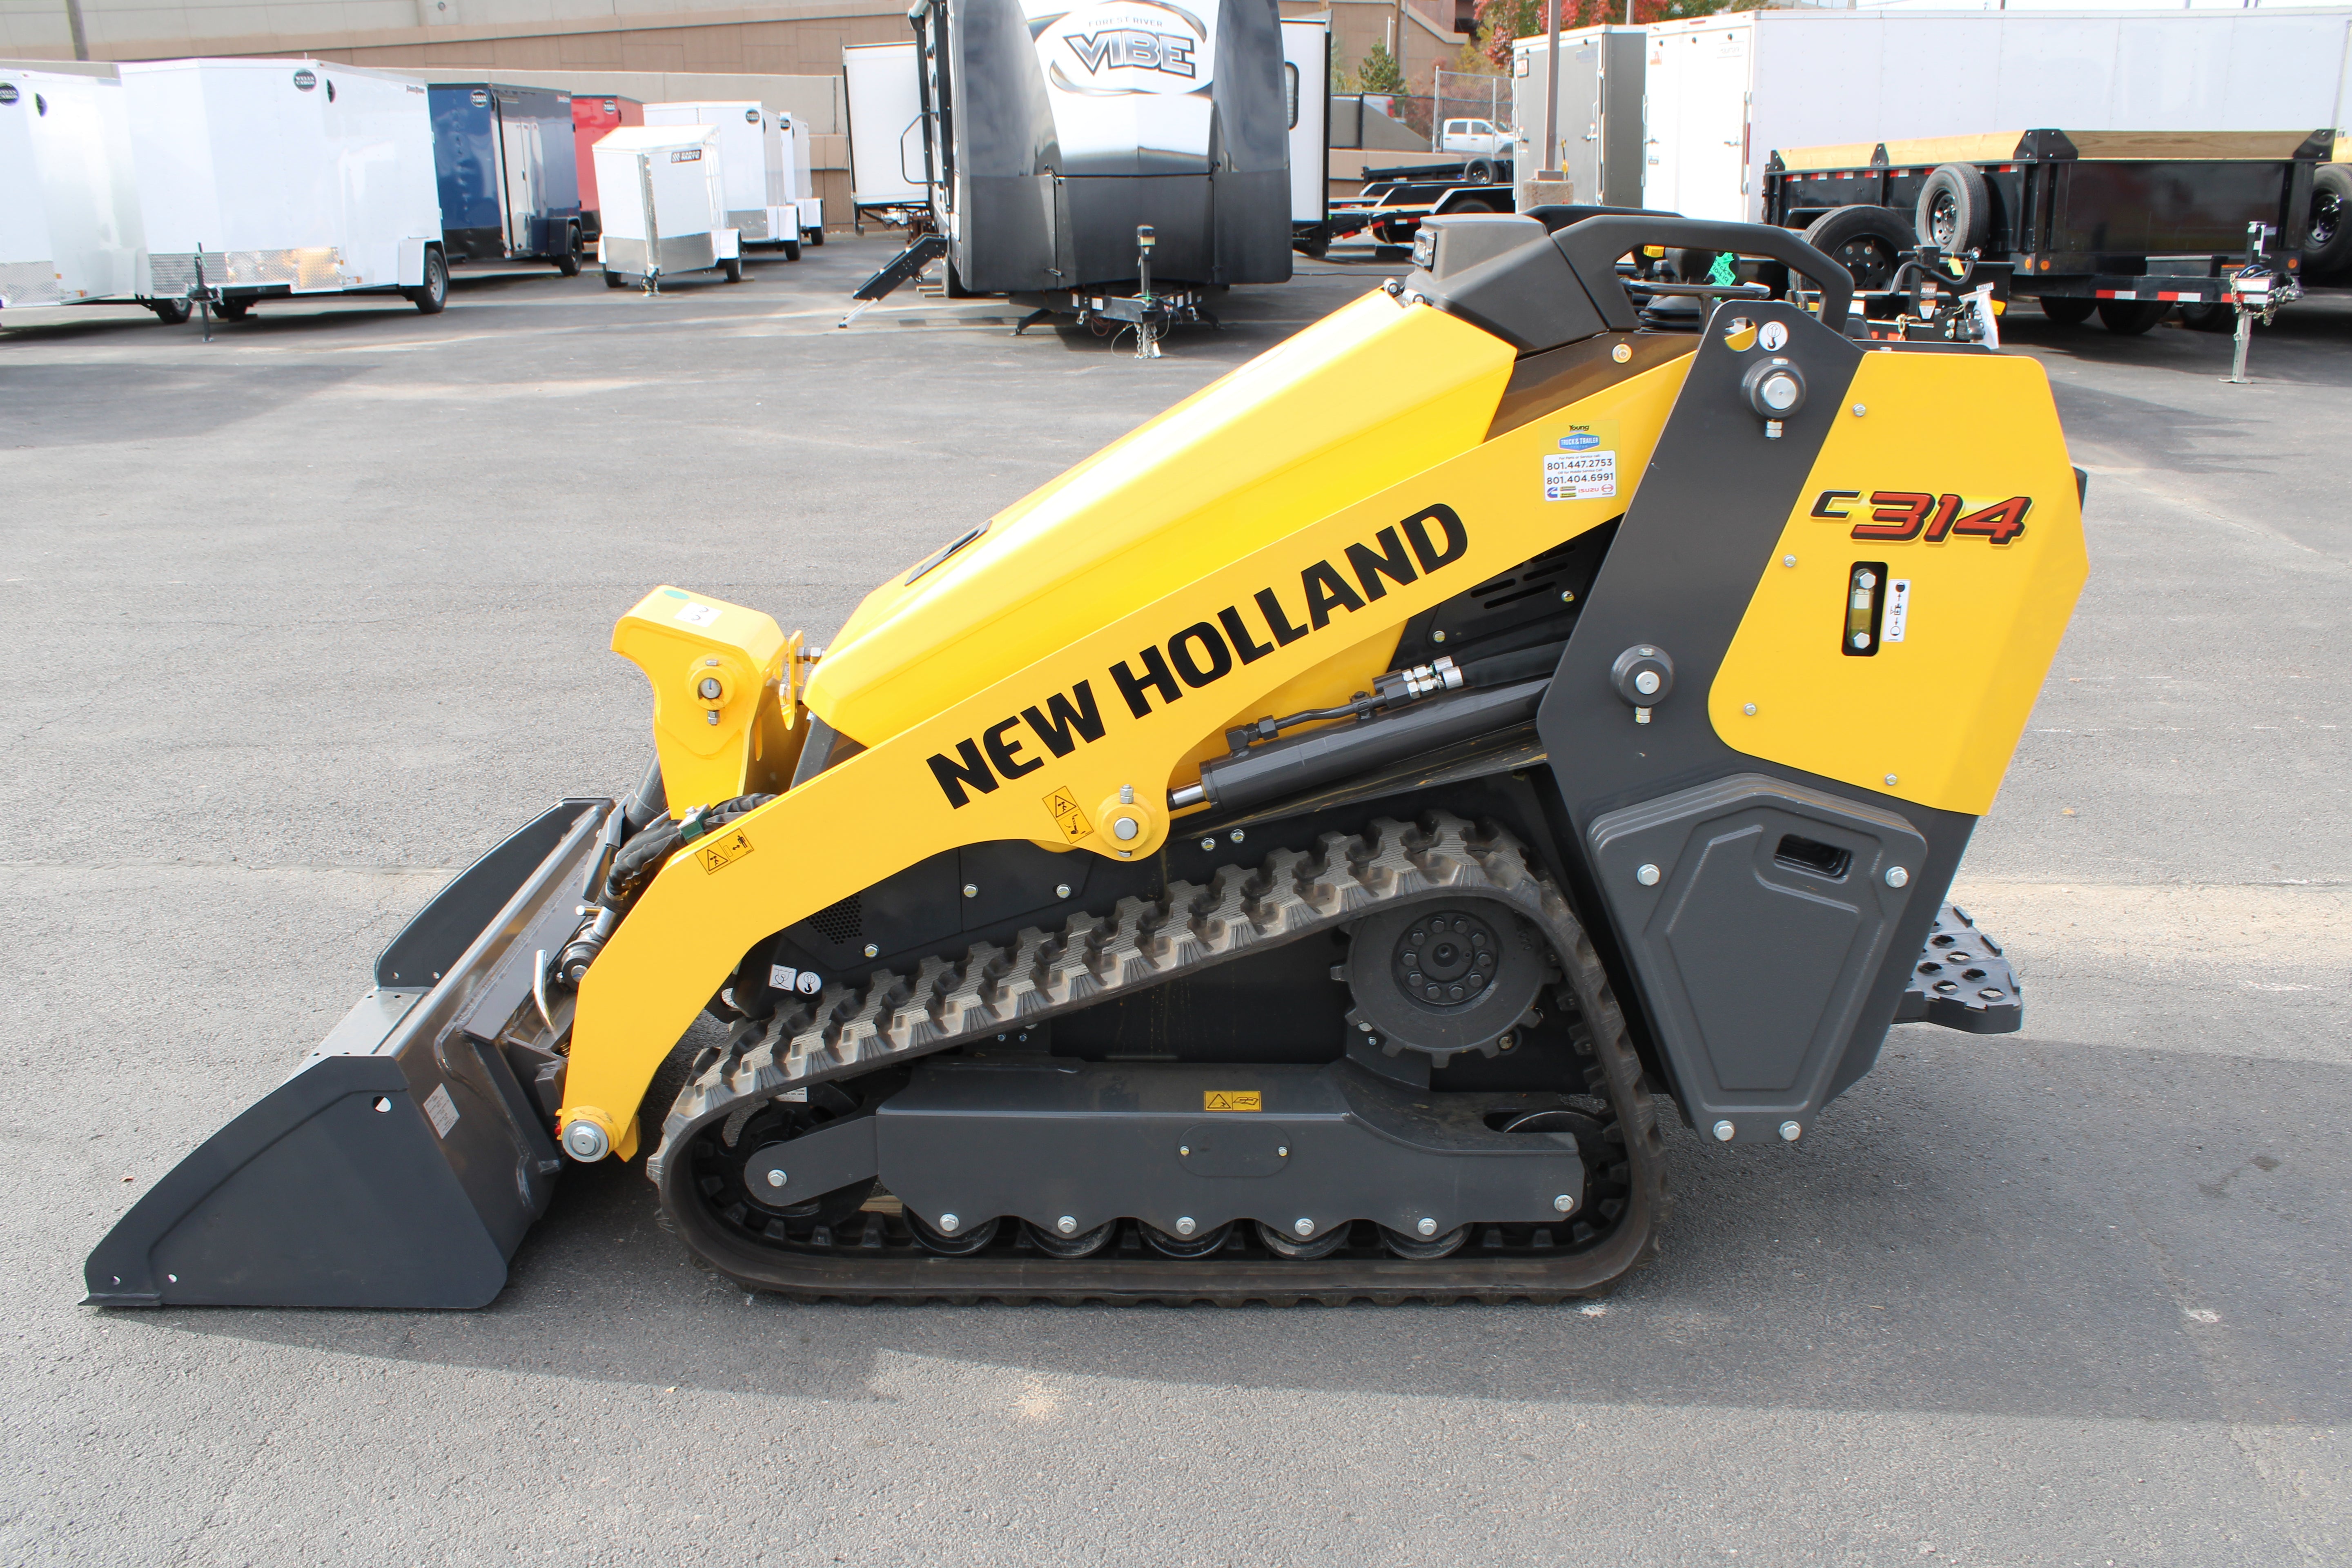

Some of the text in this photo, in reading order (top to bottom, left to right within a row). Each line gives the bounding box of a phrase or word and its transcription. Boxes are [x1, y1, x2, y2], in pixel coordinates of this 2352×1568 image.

[1089, 16, 1163, 27] FOREST RIVER
[1062, 28, 1196, 80] VIBE
[1547, 458, 1613, 470] 801.447.2753
[1547, 472, 1614, 485] 801.404.6991
[926, 503, 1468, 809] NEW HOLLAND
